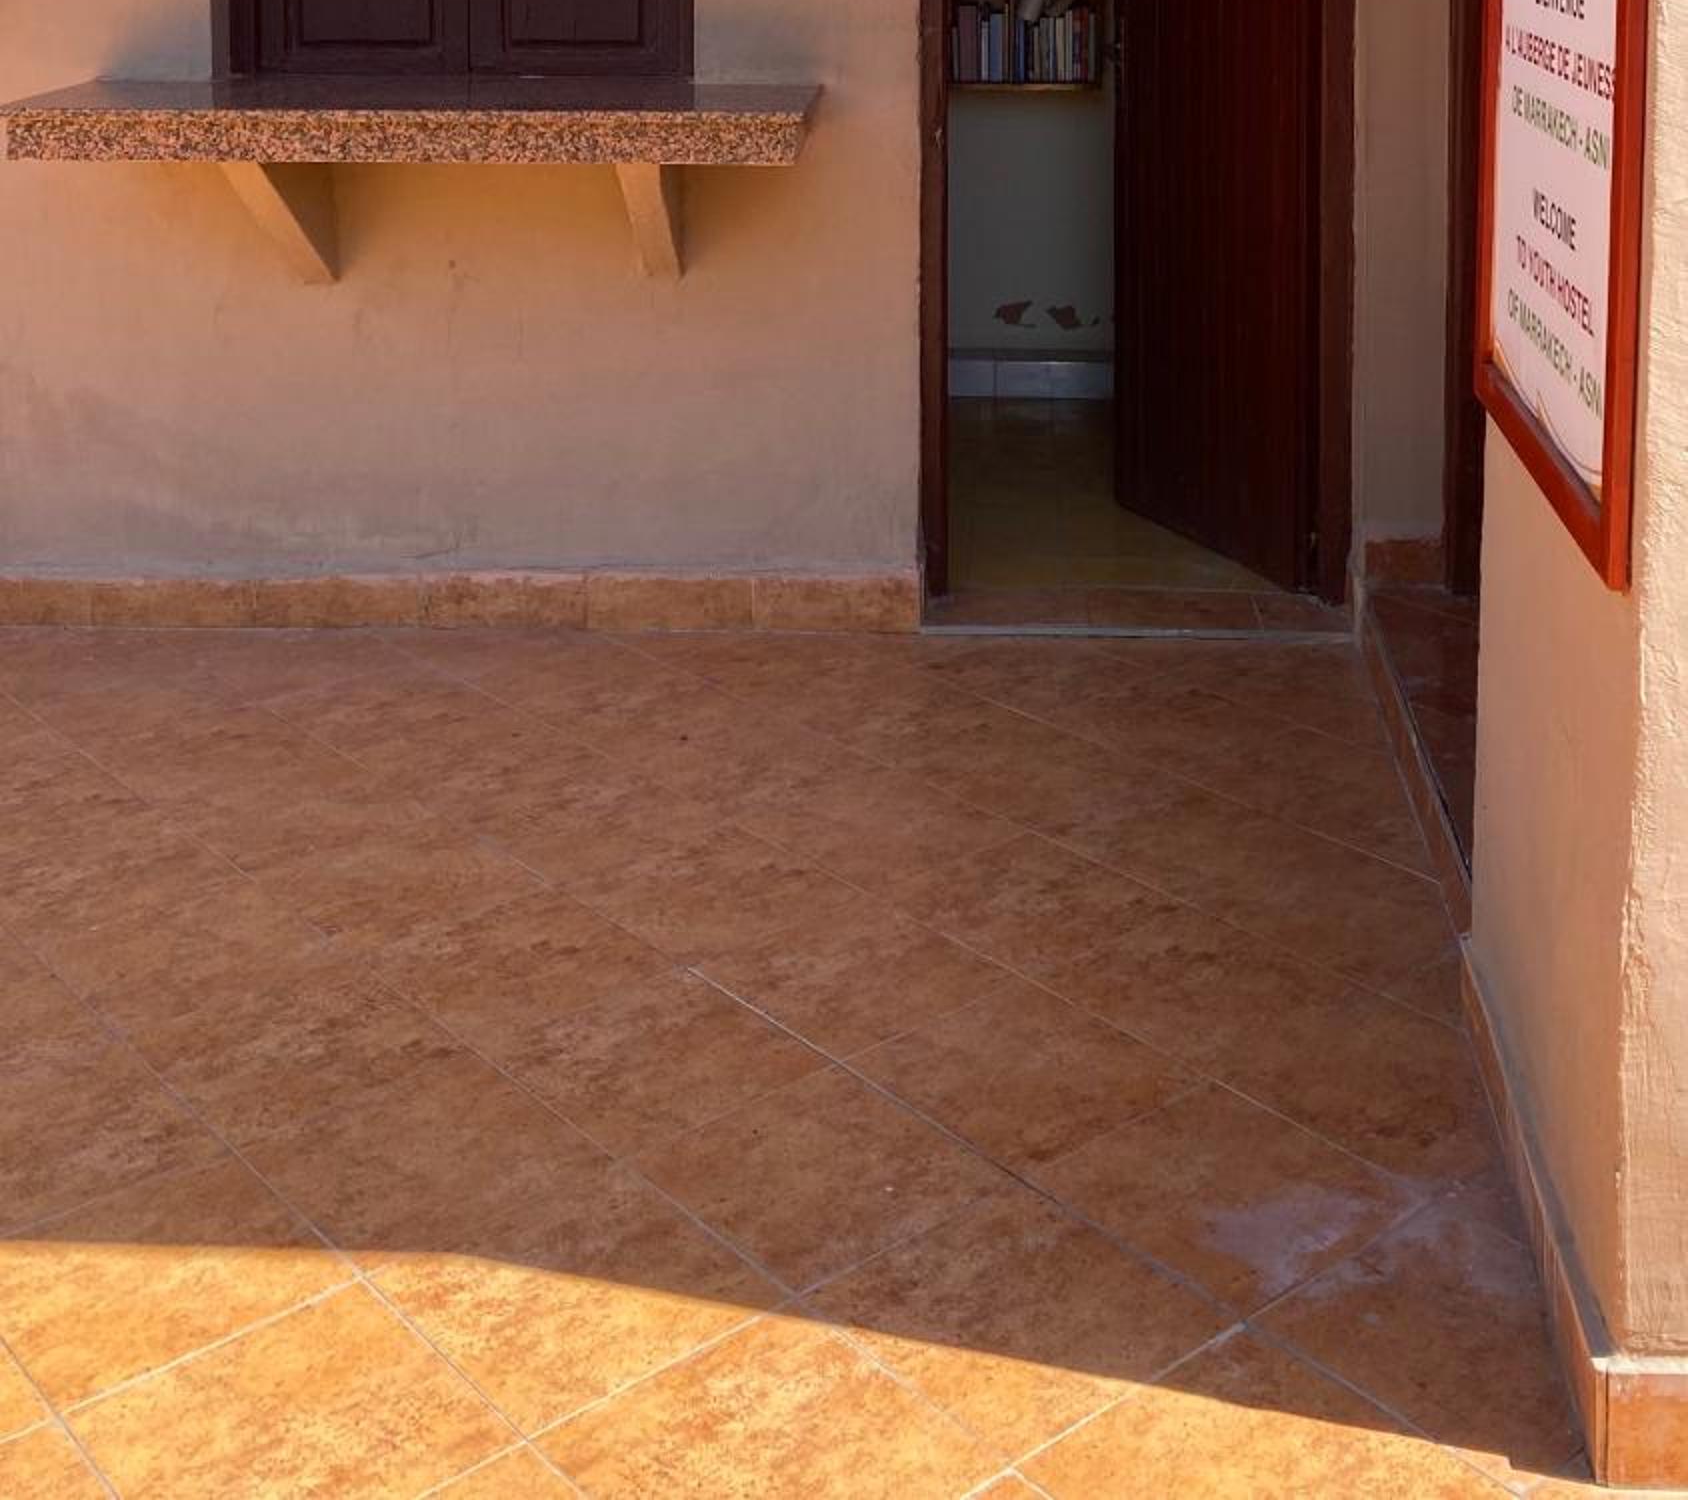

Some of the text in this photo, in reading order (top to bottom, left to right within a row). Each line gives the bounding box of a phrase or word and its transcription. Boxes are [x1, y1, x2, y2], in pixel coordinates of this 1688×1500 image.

[1557, 45, 1571, 81] DE
[1511, 84, 1523, 118] DE
[1523, 92, 1577, 152] MARRAKECH
[1533, 187, 1577, 251] WELCOME
[1515, 234, 1595, 338] TO YOUTH HOSTEL
[1508, 286, 1520, 321] OF
[1519, 300, 1573, 385] MARRAKECH
